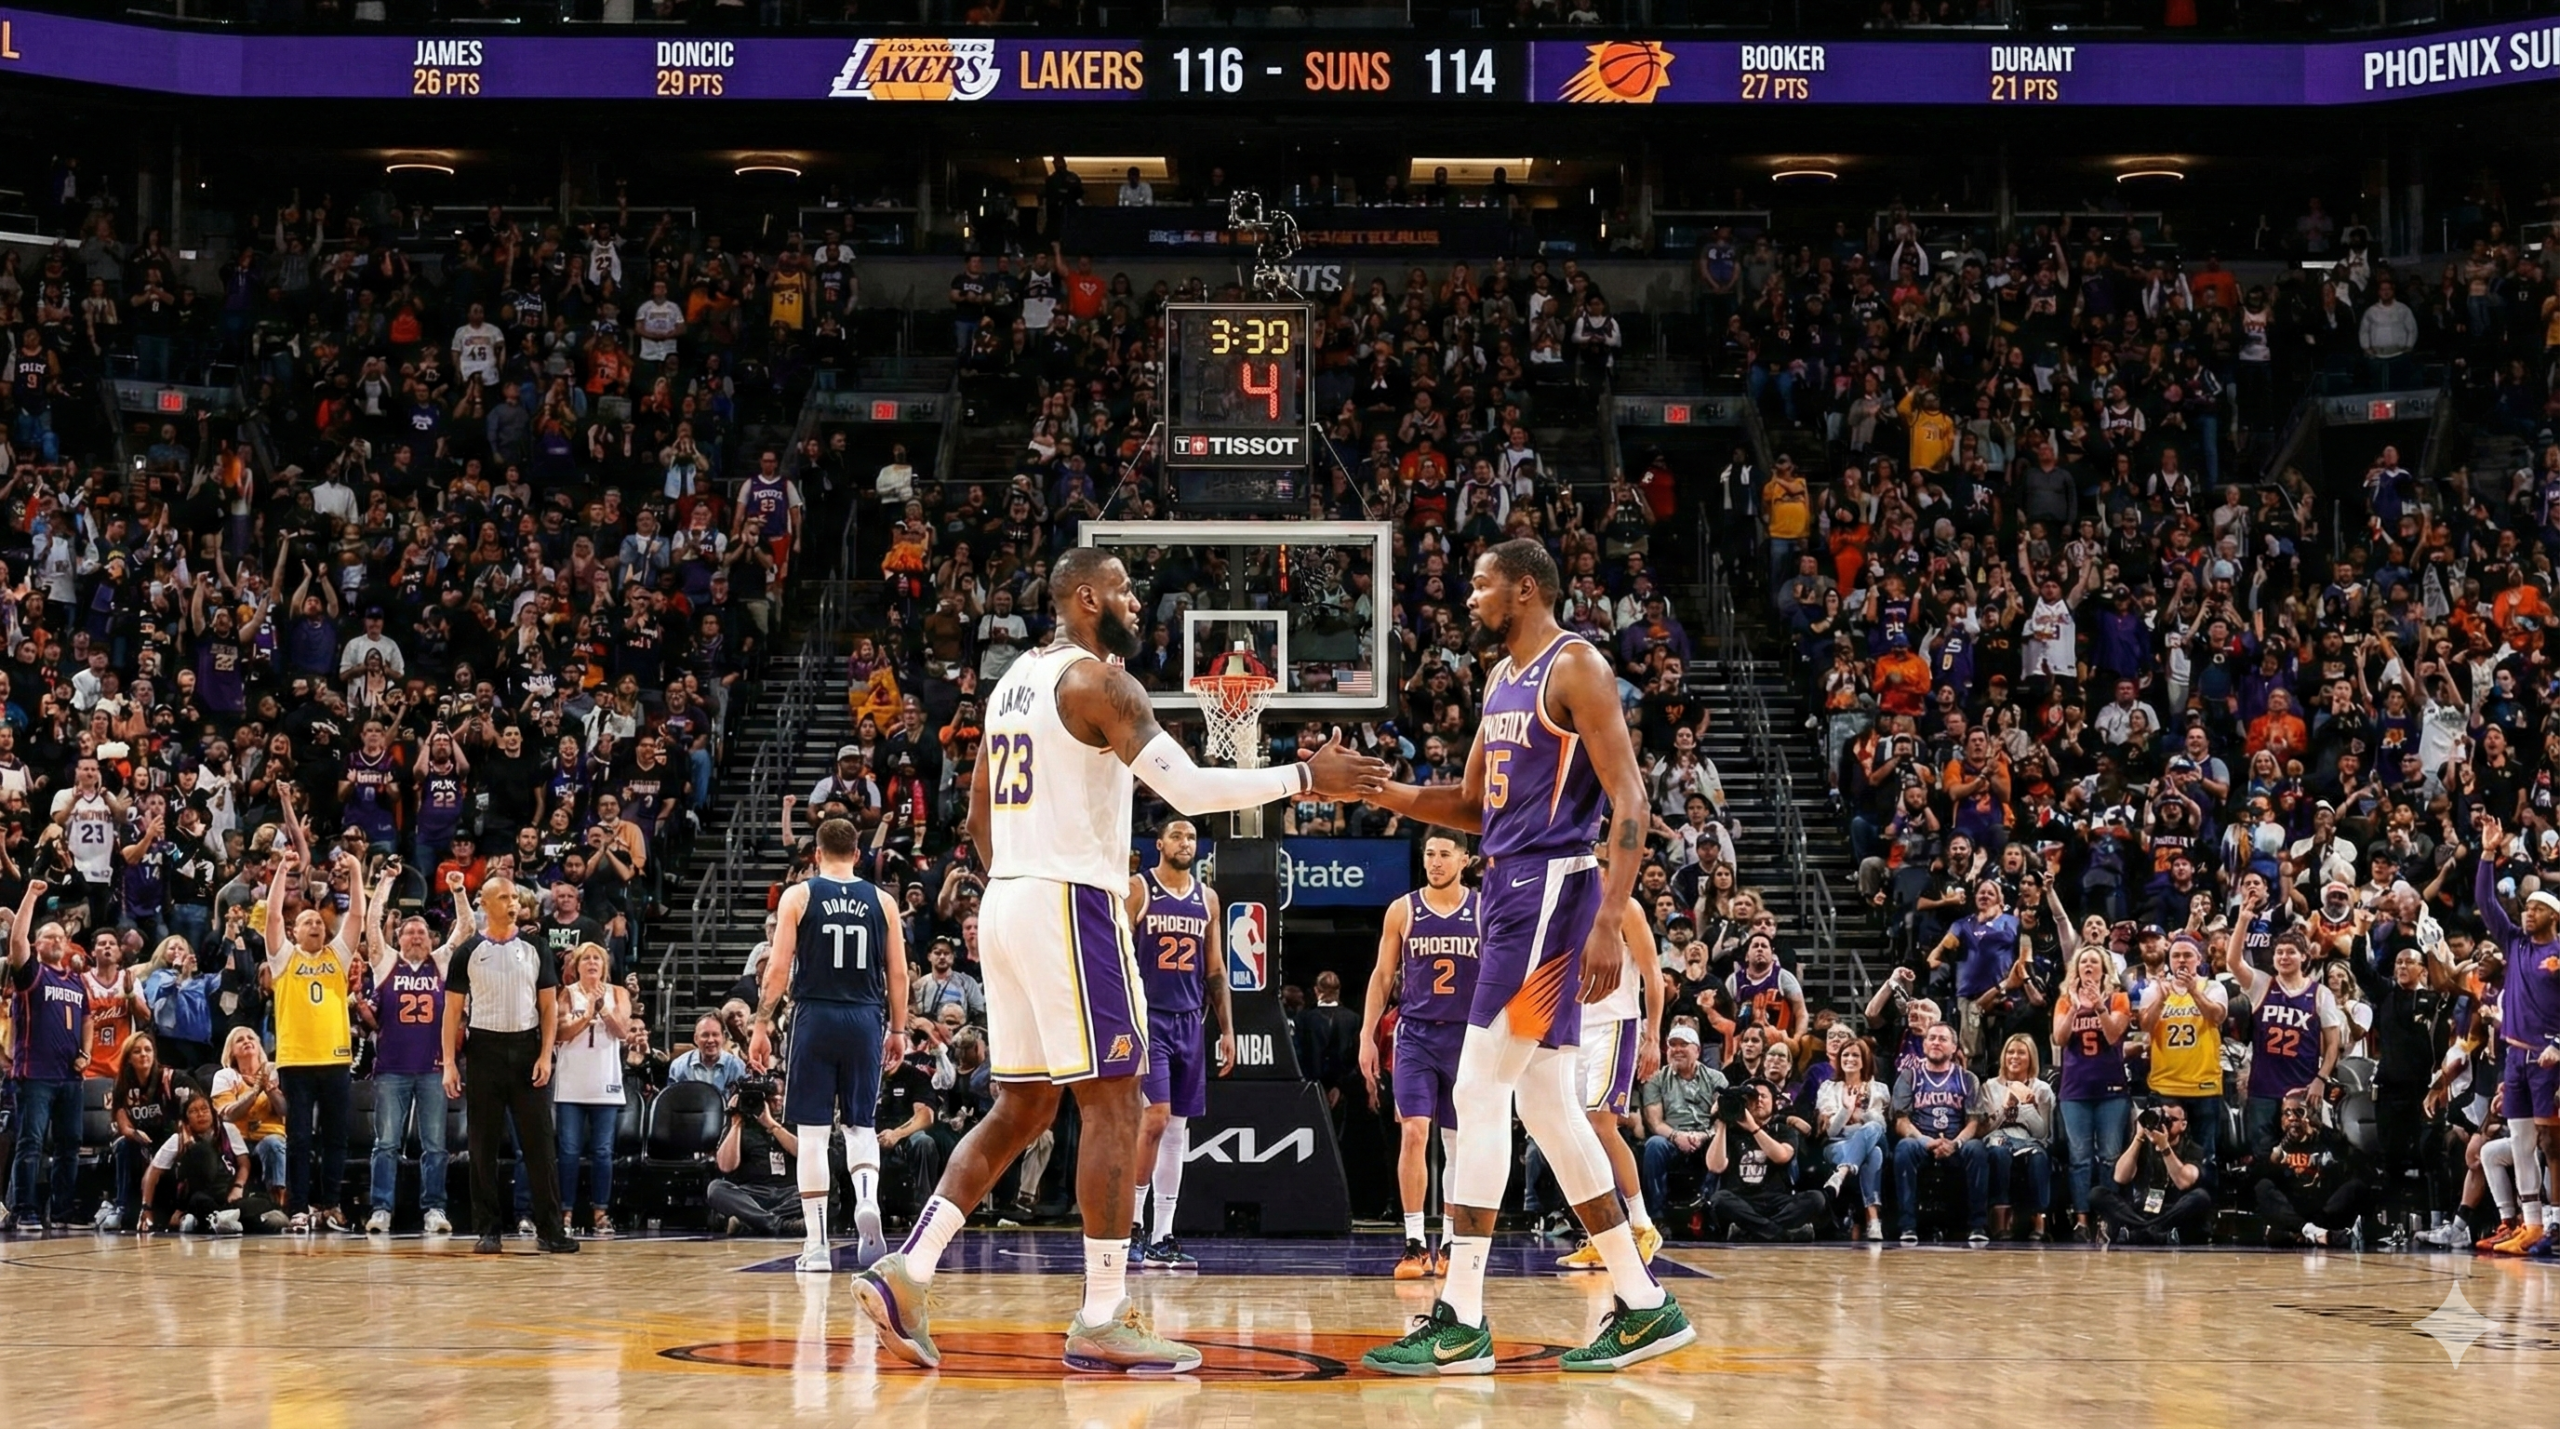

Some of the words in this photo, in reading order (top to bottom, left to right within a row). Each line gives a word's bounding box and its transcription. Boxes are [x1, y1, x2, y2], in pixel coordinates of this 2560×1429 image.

[413, 41, 483, 66] JAMES
[657, 42, 734, 67] DONCIC
[1741, 46, 1825, 71] BOOKER
[1991, 47, 2076, 72] DURANT
[2364, 36, 2501, 91] PHOENIX
[413, 69, 441, 95] 26
[446, 74, 480, 95] PTS
[839, 43, 993, 95] LAKERS
[1020, 51, 1143, 90] LAKERS
[1173, 48, 1243, 93] 116
[1305, 51, 1390, 91] SUNS
[1425, 49, 1496, 93] 114
[657, 71, 684, 96] 29
[689, 75, 723, 95] PTS
[1742, 74, 1769, 99] 27
[1774, 79, 1808, 100] PTS
[1991, 75, 2016, 100] 21
[2024, 79, 2058, 100] PTS
[1243, 362, 1278, 419] 4
[1208, 437, 1299, 455] TISSOT
[999, 685, 1035, 717] JAMES
[990, 732, 1034, 806] 23
[81, 823, 105, 844] 23
[1146, 914, 1208, 938] PHOENIX
[822, 923, 868, 969] 77
[1157, 936, 1198, 972] 22
[1408, 936, 1479, 959] PHOENIX
[1432, 958, 1456, 995] 2
[310, 980, 323, 1004] 0
[65, 1005, 73, 1031] 1
[399, 993, 434, 1024] 23
[2261, 1004, 2312, 1032] PHX
[2082, 1032, 2099, 1056] 5
[2166, 1023, 2197, 1048] 23
[2266, 1026, 2301, 1058] 22
[1236, 1034, 1274, 1066] NBA
